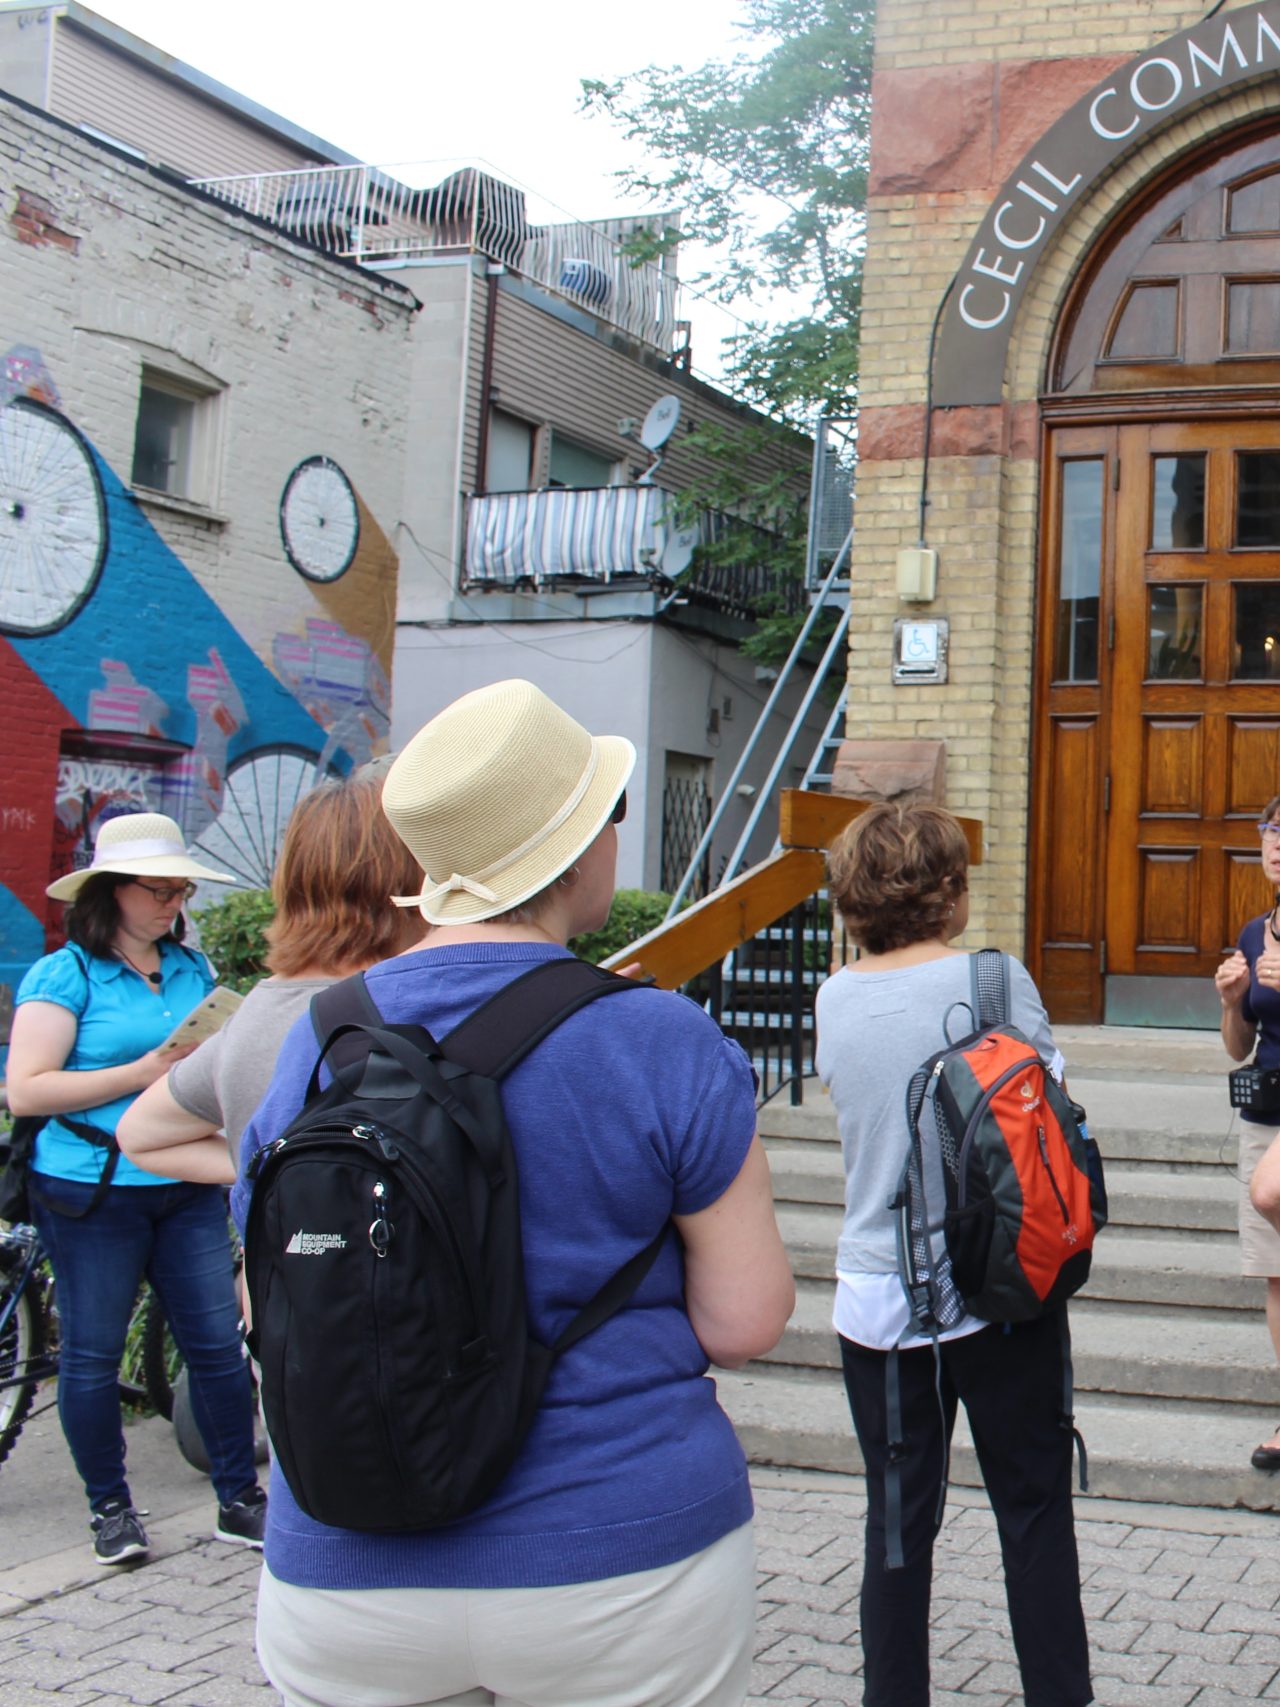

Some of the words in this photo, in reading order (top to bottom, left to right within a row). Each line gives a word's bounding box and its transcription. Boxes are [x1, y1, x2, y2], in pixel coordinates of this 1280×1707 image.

[958, 160, 1083, 330] CECIL
[302, 1233, 341, 1241] MOUNTAIN
[302, 1240, 347, 1249] EQUIPMENT
[301, 1247, 326, 1256] CO-OP
